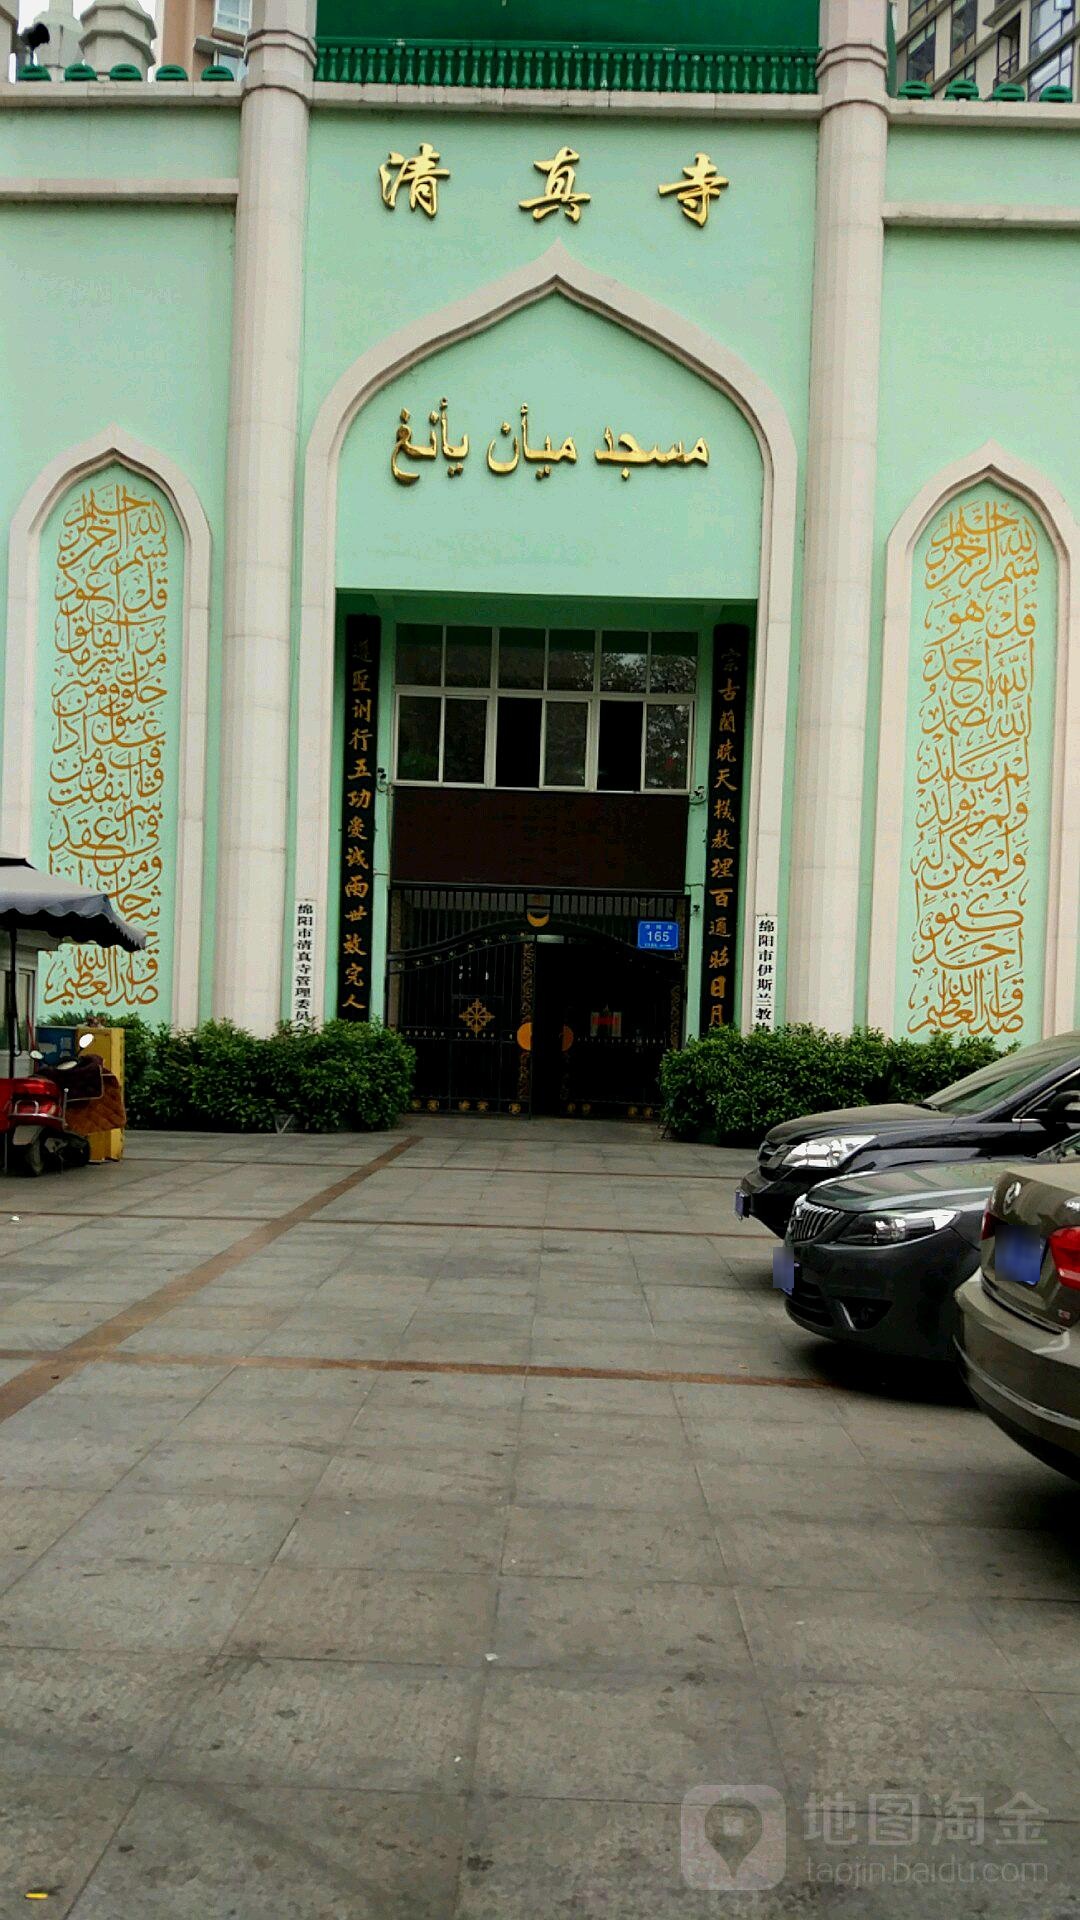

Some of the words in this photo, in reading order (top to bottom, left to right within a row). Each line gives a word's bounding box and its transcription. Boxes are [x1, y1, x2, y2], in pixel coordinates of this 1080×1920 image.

[379, 143, 729, 226] 清真寺
[594, 425, 709, 481] مسجد
[647, 931, 669, 942] 165
